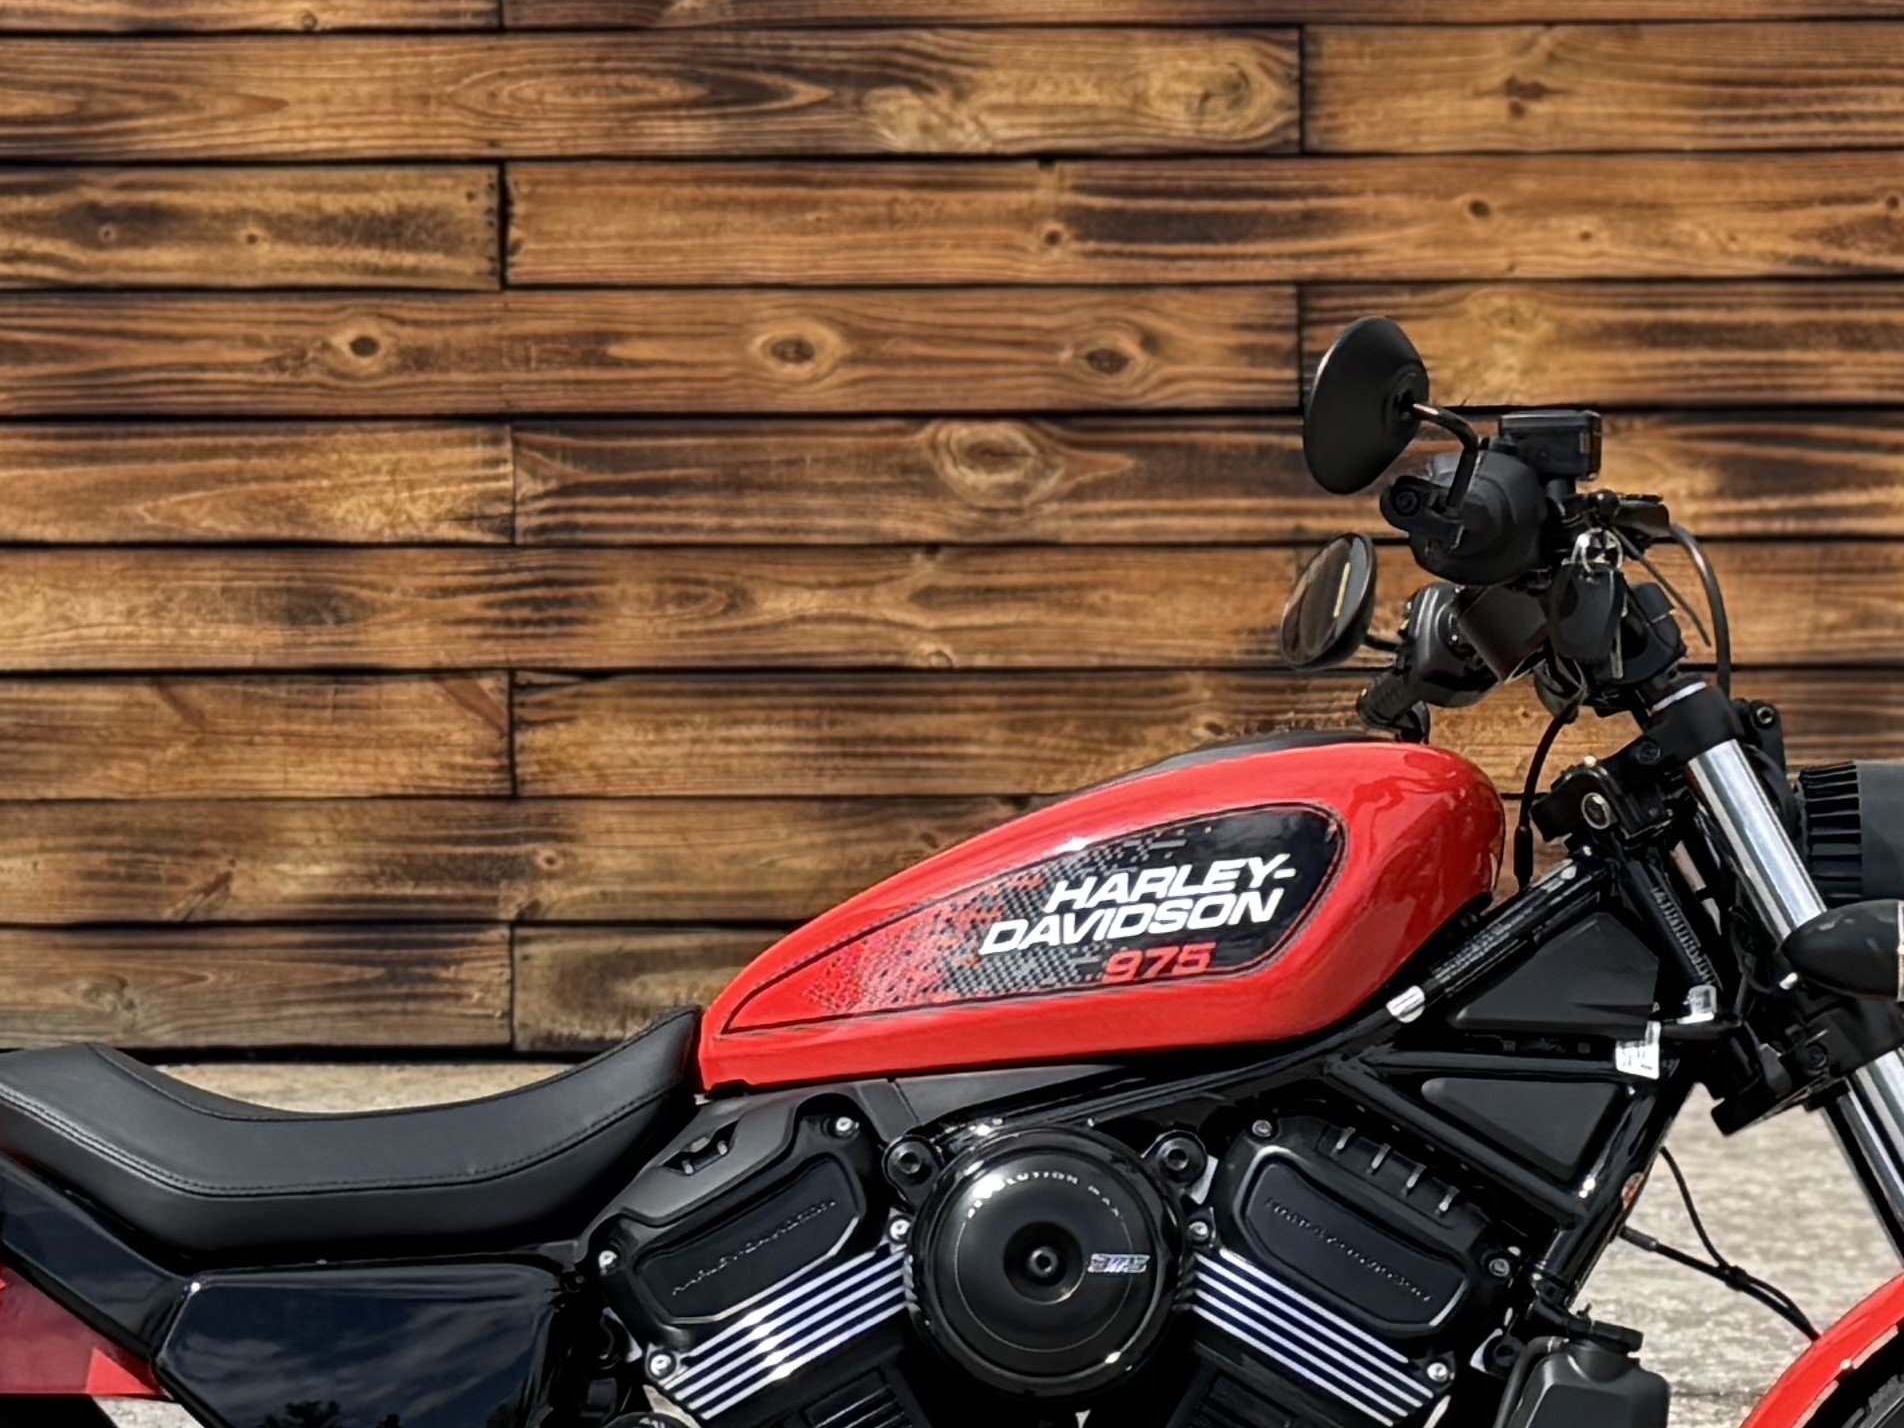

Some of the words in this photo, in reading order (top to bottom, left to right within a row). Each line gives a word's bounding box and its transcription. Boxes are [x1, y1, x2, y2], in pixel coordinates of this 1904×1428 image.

[1044, 853, 1297, 913] HARLEY-
[978, 887, 1285, 955] DAVIDSON
[1102, 942, 1217, 985] 975
